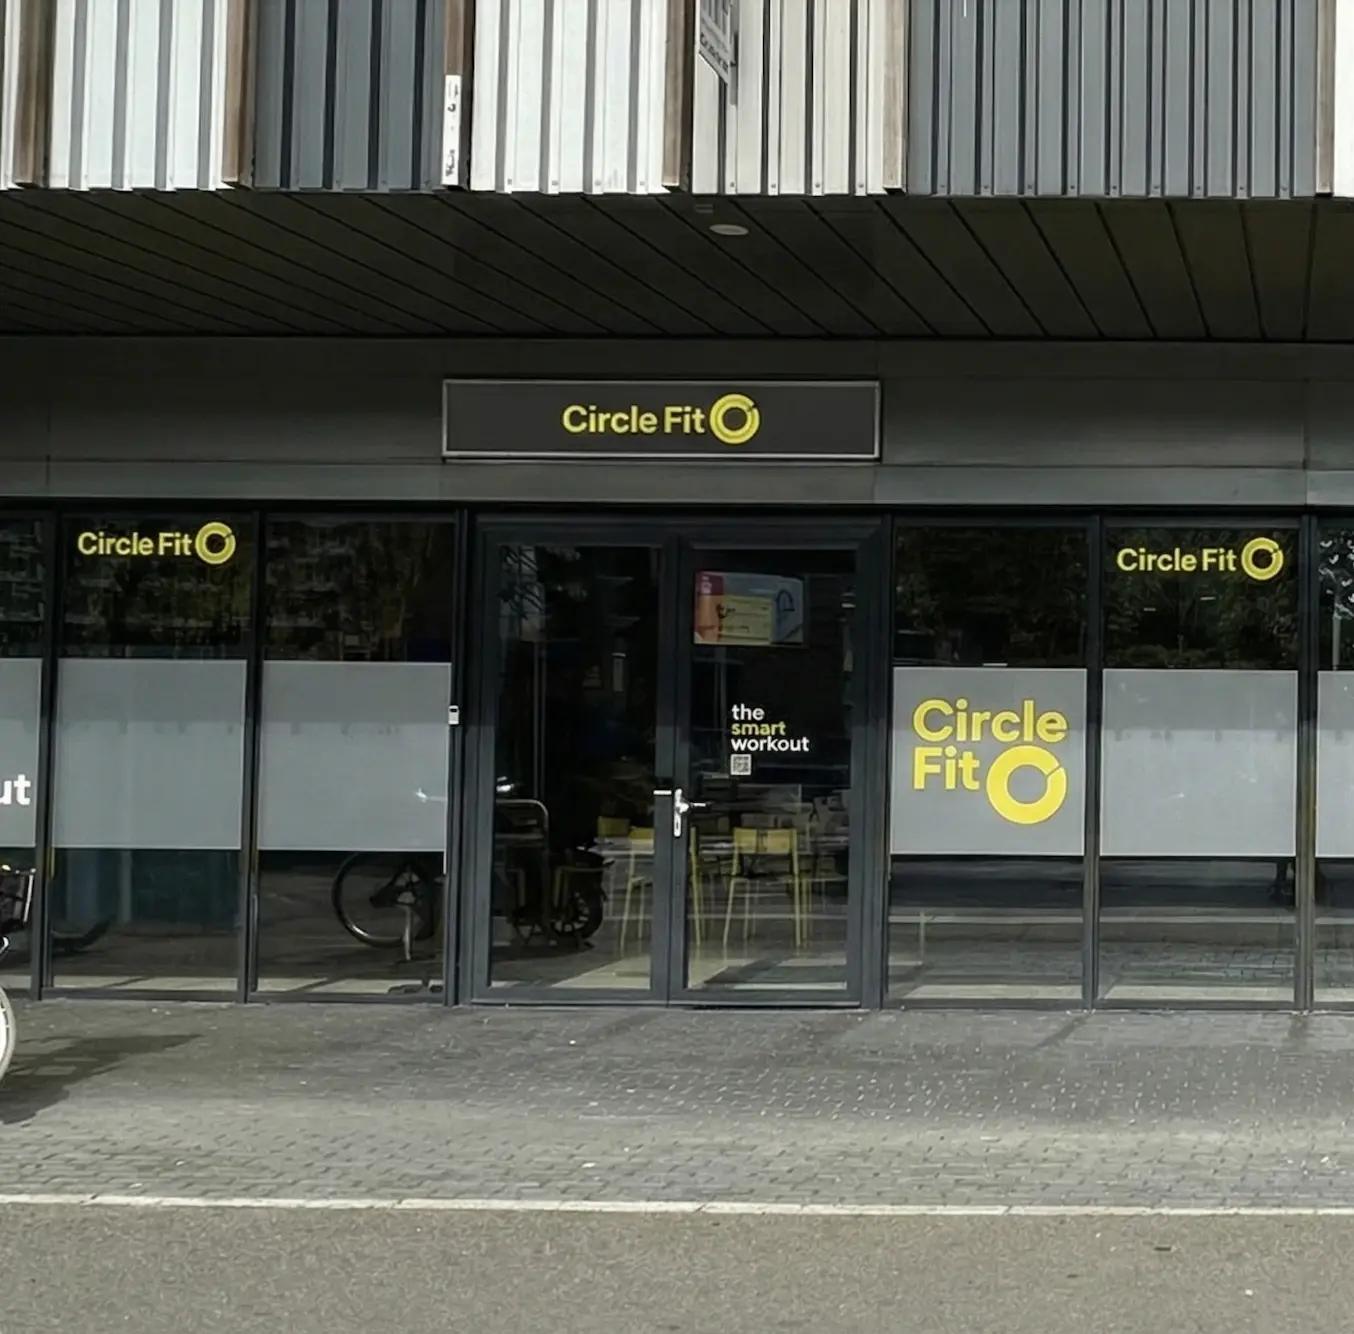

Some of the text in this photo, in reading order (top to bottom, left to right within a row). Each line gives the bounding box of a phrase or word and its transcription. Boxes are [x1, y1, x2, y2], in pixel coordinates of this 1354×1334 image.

[562, 404, 705, 434] Circle Fit
[77, 531, 193, 556] Circle Fit
[1116, 547, 1237, 573] Circle Fit
[731, 703, 765, 721] the
[912, 698, 1068, 743] Circle
[731, 721, 786, 736] smart
[731, 735, 810, 752] workout
[912, 744, 981, 790] Fit
